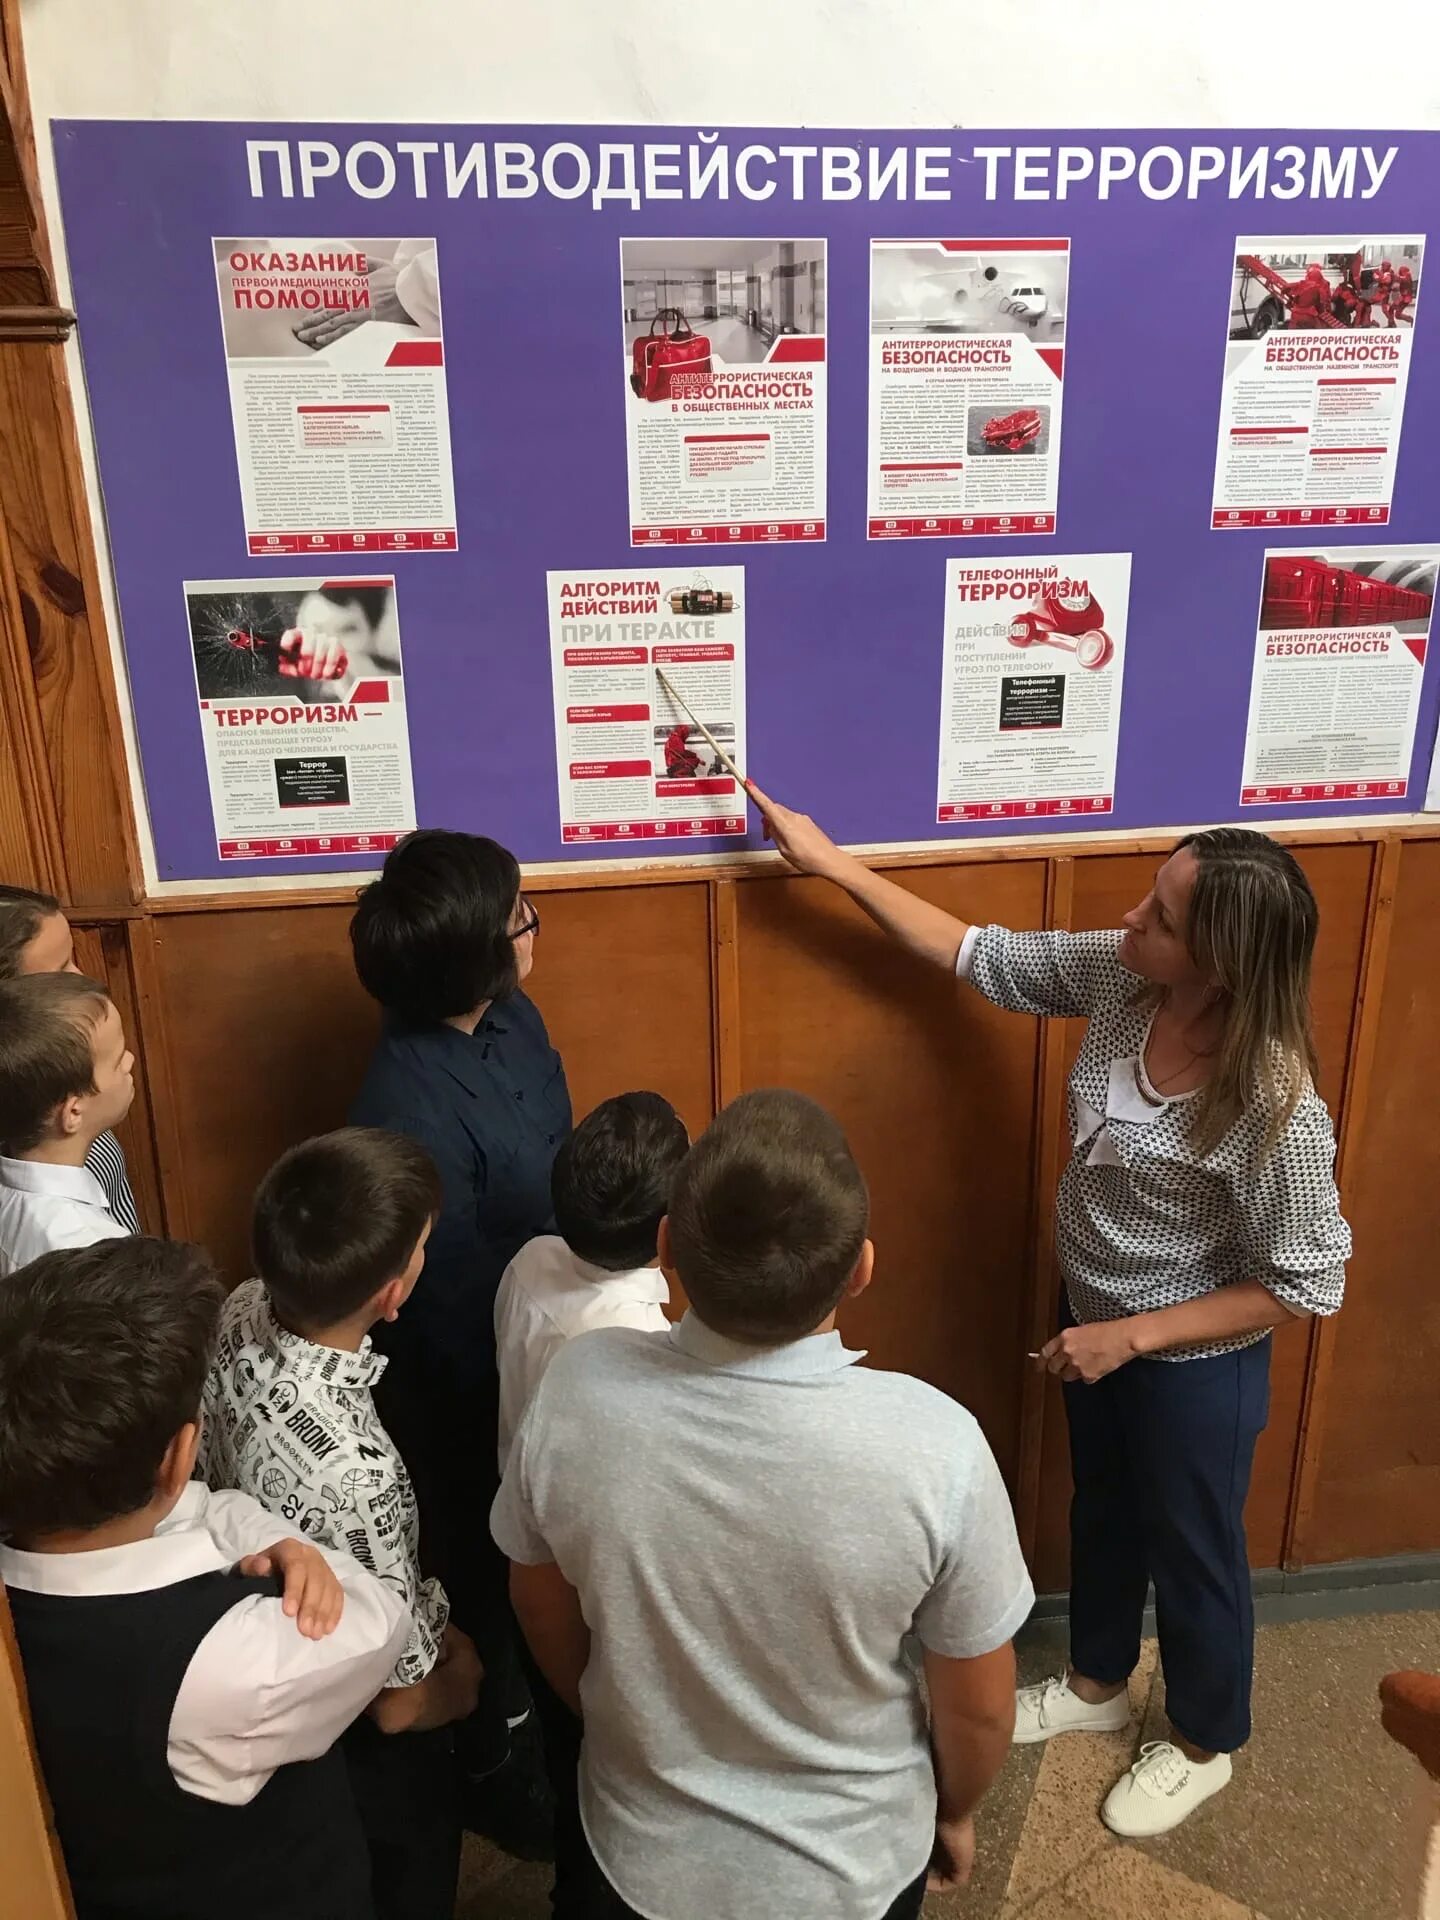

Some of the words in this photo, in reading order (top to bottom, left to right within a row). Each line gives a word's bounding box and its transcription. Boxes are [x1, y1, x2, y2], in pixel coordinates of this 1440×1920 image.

[246, 132, 951, 210] ПРОТИВОДЕЙСТВИЕ
[974, 146, 1398, 200] ТЕРРОРИЗМУ
[230, 253, 368, 271] ОКАЗАНИЕ
[232, 277, 278, 287] ПЕРВОЙ
[281, 276, 369, 288] МЕДИЦИНСКОЙ
[234, 289, 370, 312] ПОМОЩИ
[882, 340, 1012, 349] АНТИТЕРРОРИСТИЧЕСКАЯ
[1266, 335, 1402, 346] АНТИТЕРРОРИСТИЧЕСКАЯ
[882, 350, 1011, 364] БЕЗОПАСНОСТЬ
[1266, 346, 1399, 362] БЕЗОПАСНОСТЬ
[670, 372, 812, 384] АНТИТЕРРОРИСТИЧЕСКАЯ
[672, 383, 813, 400] БЕЗОПАСНОСТЬ
[672, 404, 678, 412] В
[683, 402, 770, 413] ОБЩЕСТВЕННЫХ
[774, 400, 813, 409] МЕСТАХ
[959, 565, 1058, 581] ТЕЛЕФОННЫЙ
[560, 581, 660, 598] АЛГОРИТМ
[958, 580, 1088, 601] ТЕРРОРИЗМ
[561, 597, 657, 618] ДЕЙСТВИЙ
[561, 623, 612, 643] ПРИ
[617, 621, 715, 641] ТЕРАКТЕ
[956, 624, 1025, 638] ДЕЙСТВИЯ
[1267, 632, 1391, 642] АНТИТЕРРОРИСТИЧЕСКАЯ
[955, 642, 975, 651] ПРИ
[1266, 640, 1389, 656] БЕЗОПАСНОСТЬ
[954, 652, 1026, 662] ПОСТУПЛЕНИИ
[954, 665, 984, 674] УГРОЗ
[1002, 662, 1053, 672] ТЕЛЕФОНУ
[1012, 677, 1055, 686] Телефонный
[214, 705, 358, 727] ТЕРРОРИЗМ
[260, 728, 298, 736] ЯВЛЕНИЕ
[300, 726, 348, 736] ОБЩЕСТВА,
[217, 738, 298, 747] ПРЕДСТАВЛЯЮЩЕЕ
[238, 747, 283, 756] КАЖДОГО
[285, 746, 329, 754] ЧЕЛОВЕКА
[339, 742, 397, 751] ГОСУДАРСТВА
[320, 1351, 342, 1381] BRONX
[344, 1360, 356, 1368] NY
[272, 1388, 291, 1408] NYC
[309, 1406, 340, 1437] RADICAL
[284, 1408, 340, 1461] BRONX
[274, 1432, 314, 1476] BROOKLYN
[281, 1494, 304, 1520] 82
